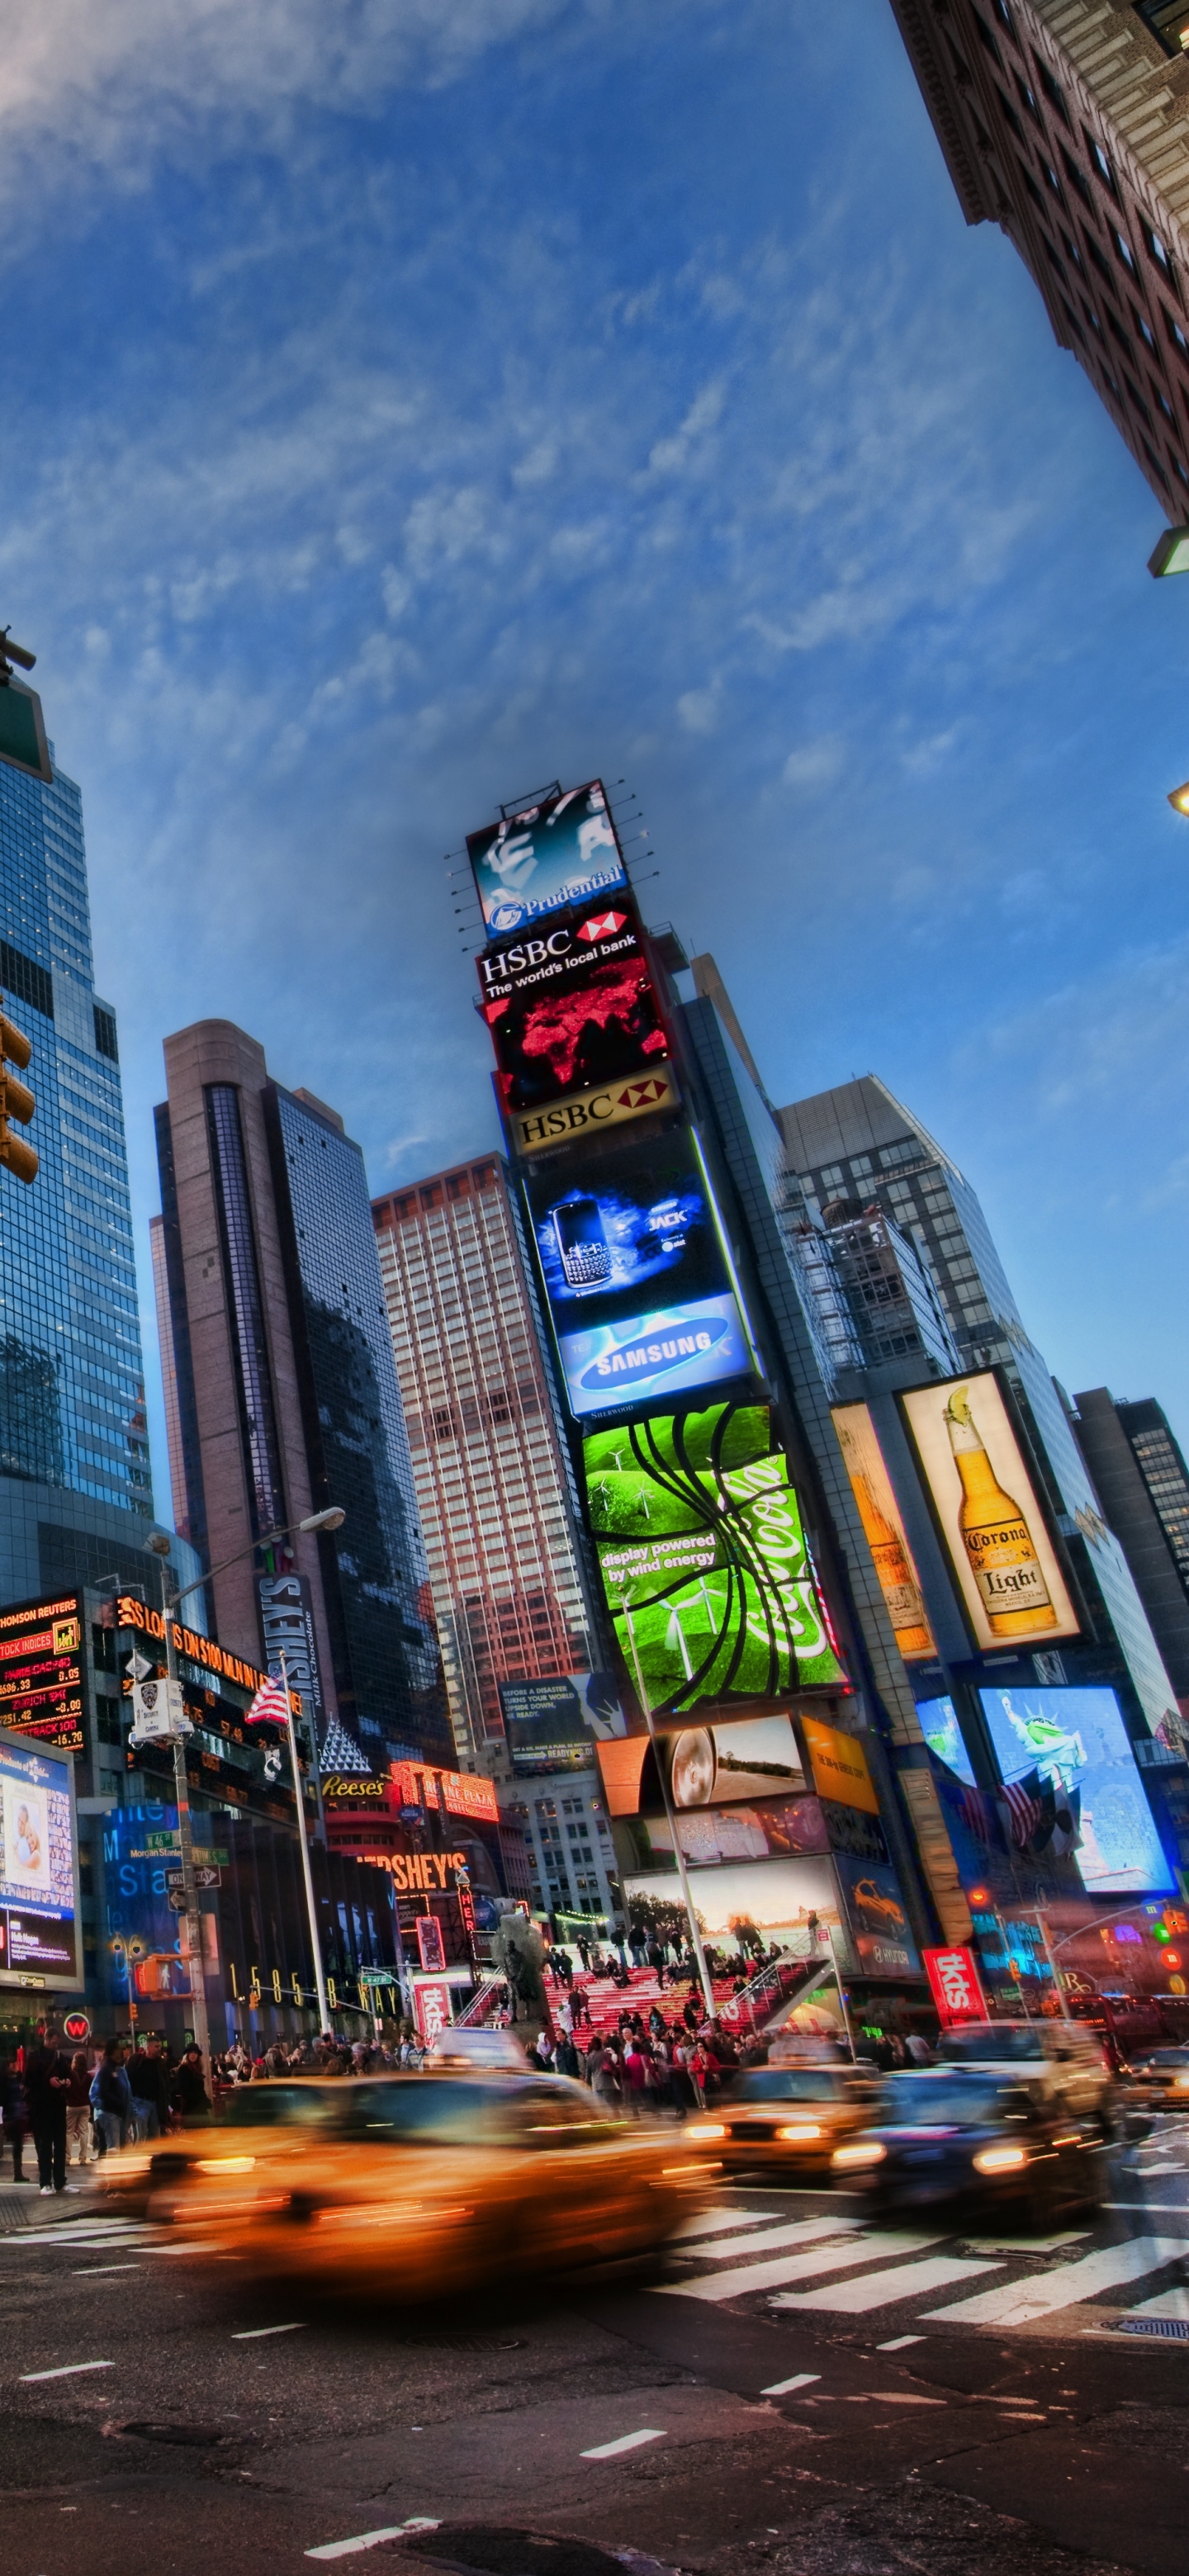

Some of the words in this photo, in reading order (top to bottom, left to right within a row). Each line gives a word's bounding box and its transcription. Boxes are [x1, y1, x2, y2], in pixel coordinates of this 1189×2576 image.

[523, 866, 622, 917] Prudential
[481, 929, 572, 983] HSBC
[486, 981, 512, 998] The
[515, 962, 563, 987] world's
[566, 947, 598, 969] local
[600, 934, 637, 955] bank
[519, 1093, 614, 1145] HSBC
[648, 1210, 688, 1232] JACK
[596, 1332, 712, 1376] SAMSUNG
[590, 1404, 634, 1419] SHERWOOD
[601, 1546, 649, 1568] display
[651, 1533, 716, 1557] powered
[968, 1527, 1027, 1551] Corona
[608, 1569, 626, 1583] by
[628, 1558, 661, 1577] wind
[663, 1551, 716, 1566] energy
[983, 1569, 1038, 1596] Light
[0, 1610, 37, 1629] HOMSON
[38, 1598, 77, 1619] REUTERS
[21, 1634, 51, 1651] INDICES
[259, 1576, 315, 1702] RSHEY'S
[305, 1611, 319, 1675] Chocolate
[312, 1676, 322, 1707] Milk
[536, 1685, 567, 1694] DISASTER
[548, 1693, 575, 1701] WORLD
[505, 1704, 529, 1712] UPSIDE
[322, 1775, 385, 1797] Reese's
[130, 1849, 159, 1859] Morgan
[147, 1836, 154, 1848] W
[154, 1831, 163, 1847] 46
[173, 1873, 184, 1883] ON
[196, 1870, 212, 1881] WAY
[357, 1853, 467, 1890] SHEY'S
[882, 1949, 910, 1965] HYUNDAI
[937, 1953, 971, 2010] tkts
[423, 1986, 445, 2038] tkts
[67, 2021, 87, 2037] W
